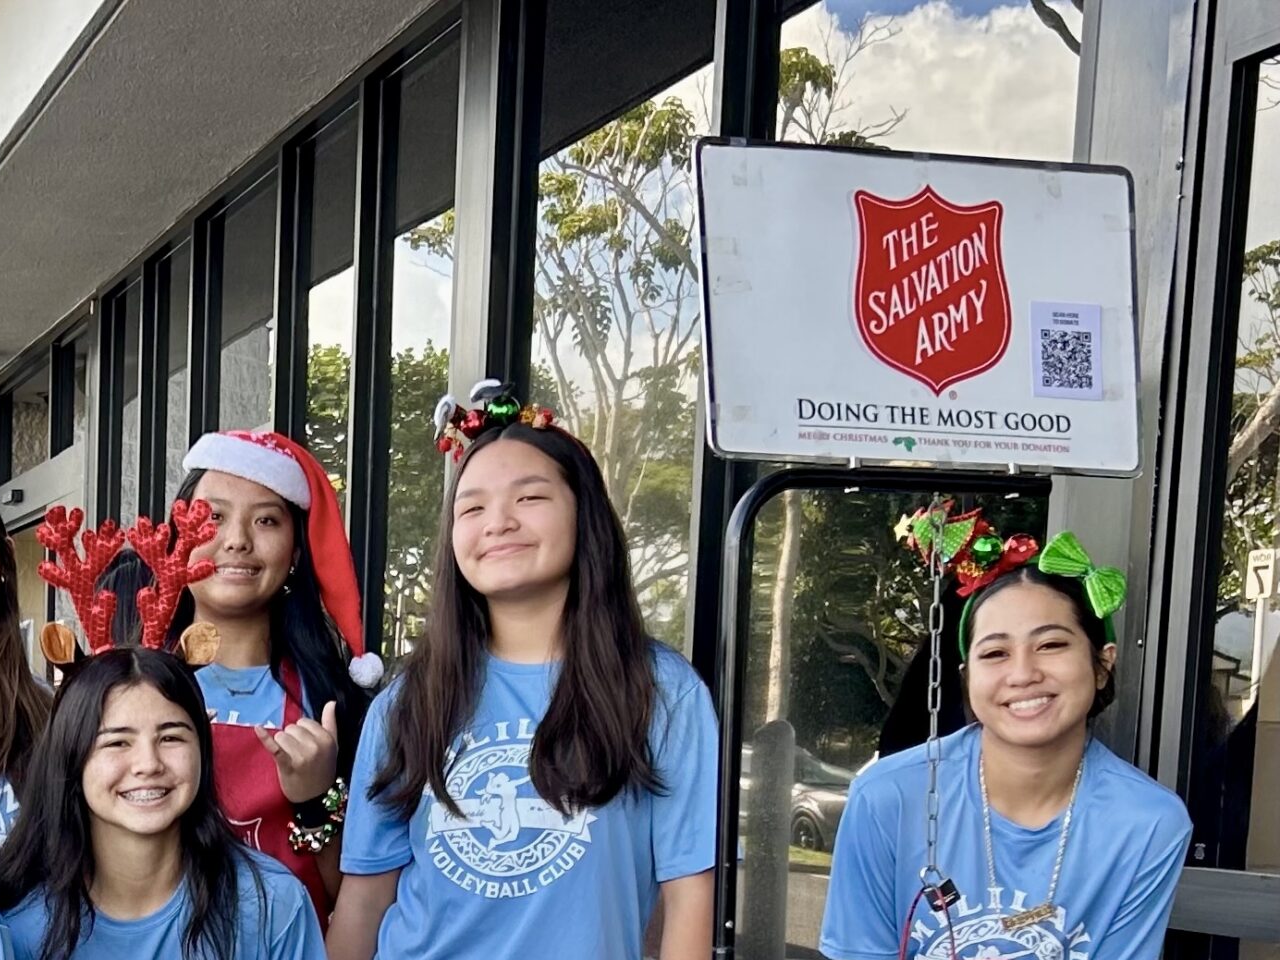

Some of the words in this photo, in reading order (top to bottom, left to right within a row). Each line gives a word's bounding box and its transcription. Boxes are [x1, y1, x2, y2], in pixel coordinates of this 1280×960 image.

[883, 212, 939, 270] THE
[868, 222, 989, 335] SALVATION
[915, 279, 987, 365] ARMY
[797, 398, 879, 423] DOING
[885, 405, 930, 426] THE
[937, 408, 997, 430] MOST
[1004, 412, 1072, 433] GOOD
[833, 432, 888, 443] CHRISTMAS
[918, 437, 950, 447] THANK
[952, 439, 971, 448] YOU
[974, 440, 992, 449] FOR
[994, 441, 1019, 450] YOUR
[1022, 442, 1070, 453] DONATION
[428, 840, 537, 898] VOLLEYBALL
[538, 842, 586, 886] CLUB
